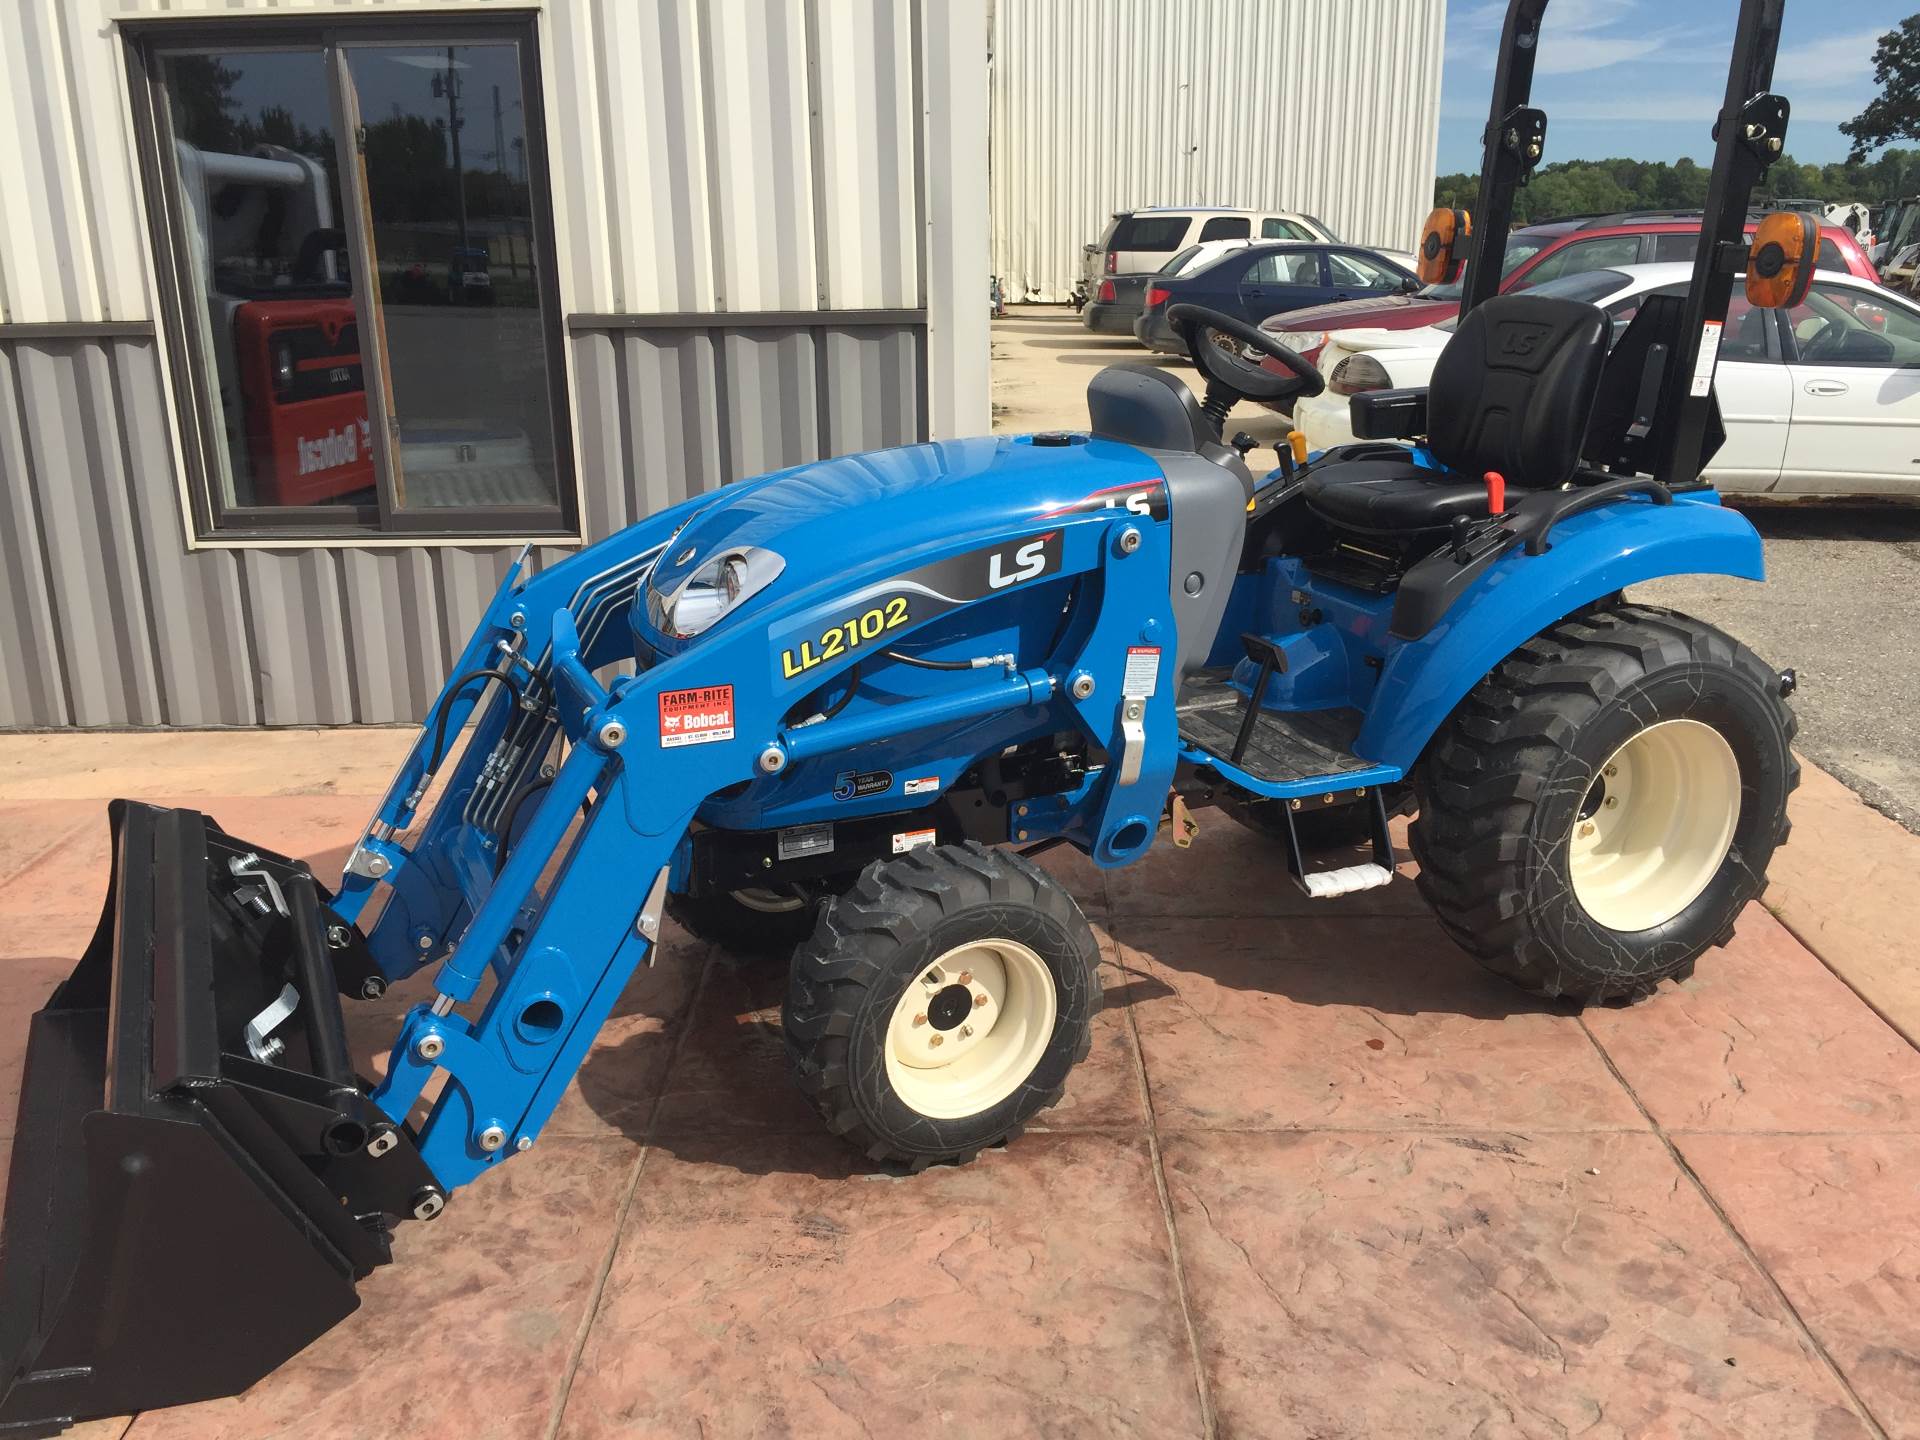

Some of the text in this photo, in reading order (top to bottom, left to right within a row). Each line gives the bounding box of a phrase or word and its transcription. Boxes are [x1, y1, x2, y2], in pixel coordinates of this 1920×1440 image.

[1503, 332, 1537, 356] LS
[988, 540, 1046, 589] LS
[781, 596, 909, 680] LL2102
[663, 688, 729, 706] FARM-RITE
[664, 703, 710, 713] EQUIPMENT
[683, 710, 730, 730] Bobcat
[833, 770, 874, 801] 5 YEAR
[857, 780, 889, 791] WARRANTY
